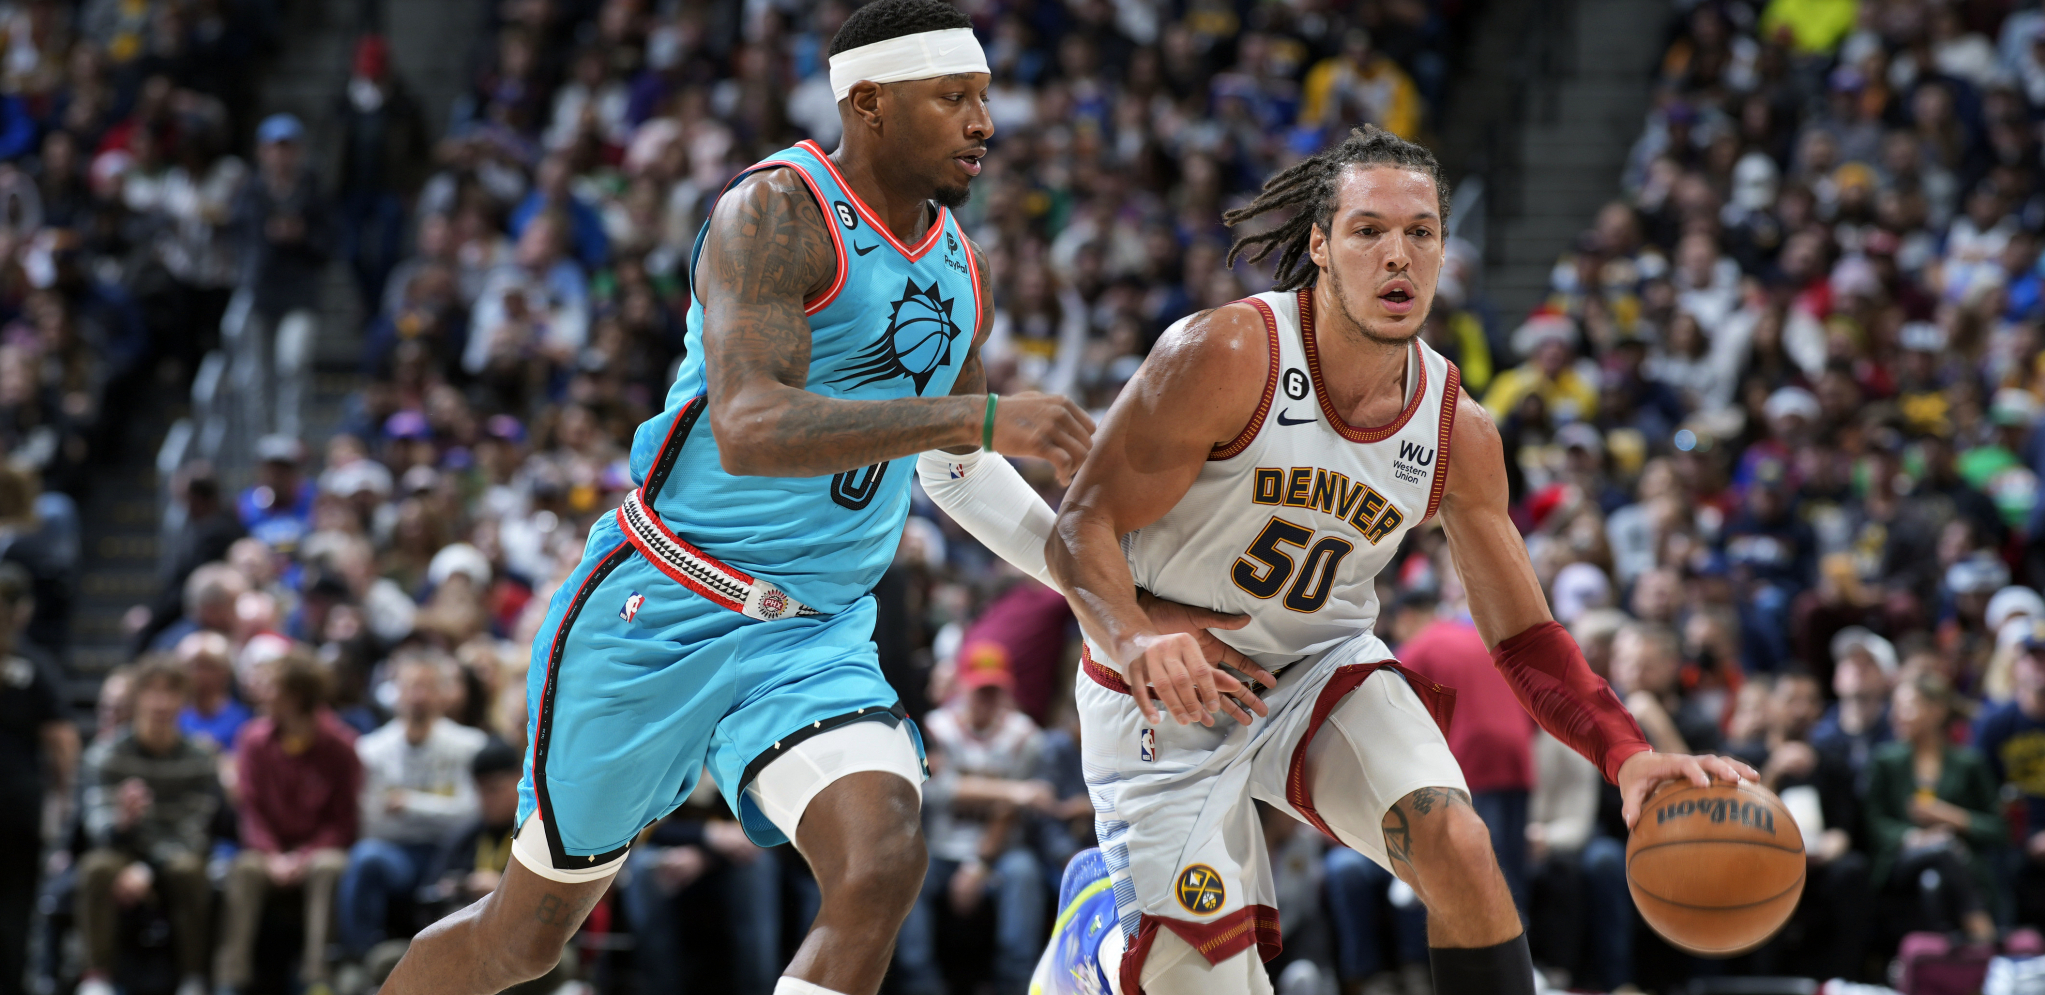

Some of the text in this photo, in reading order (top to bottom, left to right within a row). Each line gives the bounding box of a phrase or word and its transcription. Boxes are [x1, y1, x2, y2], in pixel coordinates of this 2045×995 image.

[836, 204, 854, 227] 6
[944, 254, 968, 274] PayPal
[1288, 372, 1303, 397] 6
[1399, 439, 1434, 466] WU
[1393, 460, 1427, 478] Western
[1395, 469, 1419, 485] Union
[1252, 466, 1404, 546] DENVER
[1230, 515, 1355, 614] 50
[765, 599, 783, 610] PHX
[1656, 796, 1777, 836] Wilson
